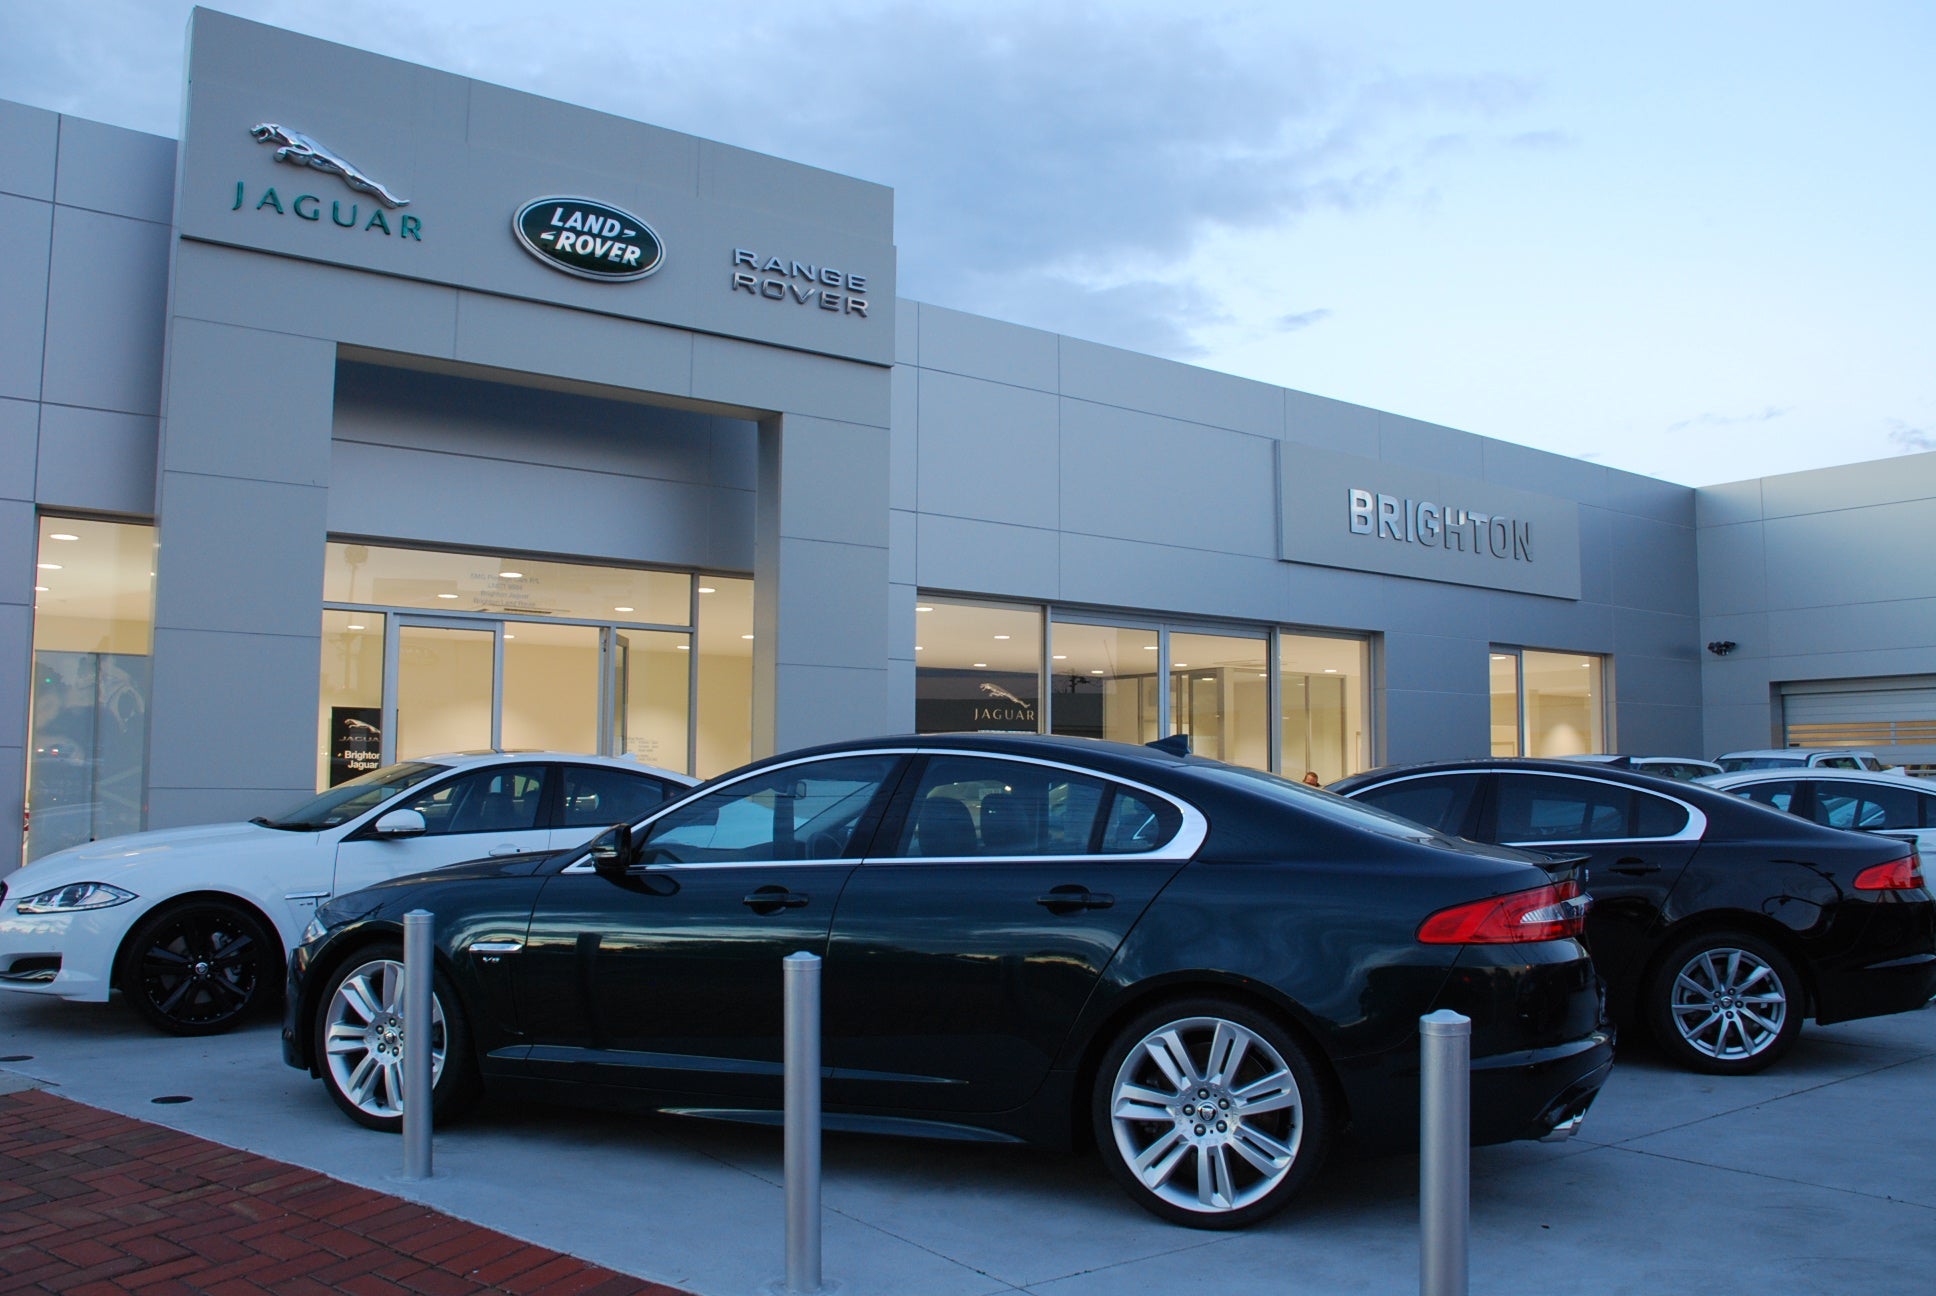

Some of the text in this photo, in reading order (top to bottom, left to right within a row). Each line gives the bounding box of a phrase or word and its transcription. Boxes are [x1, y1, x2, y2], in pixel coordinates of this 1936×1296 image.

[232, 181, 422, 241] JAGUAR
[550, 207, 621, 238] LAND
[555, 231, 641, 266] ROVER
[733, 248, 867, 293] RANGE
[733, 272, 869, 318] ROVER
[1348, 488, 1533, 562] BRIGHTON
[974, 708, 1034, 720] JAGUAR
[347, 760, 379, 771] Jaguar
